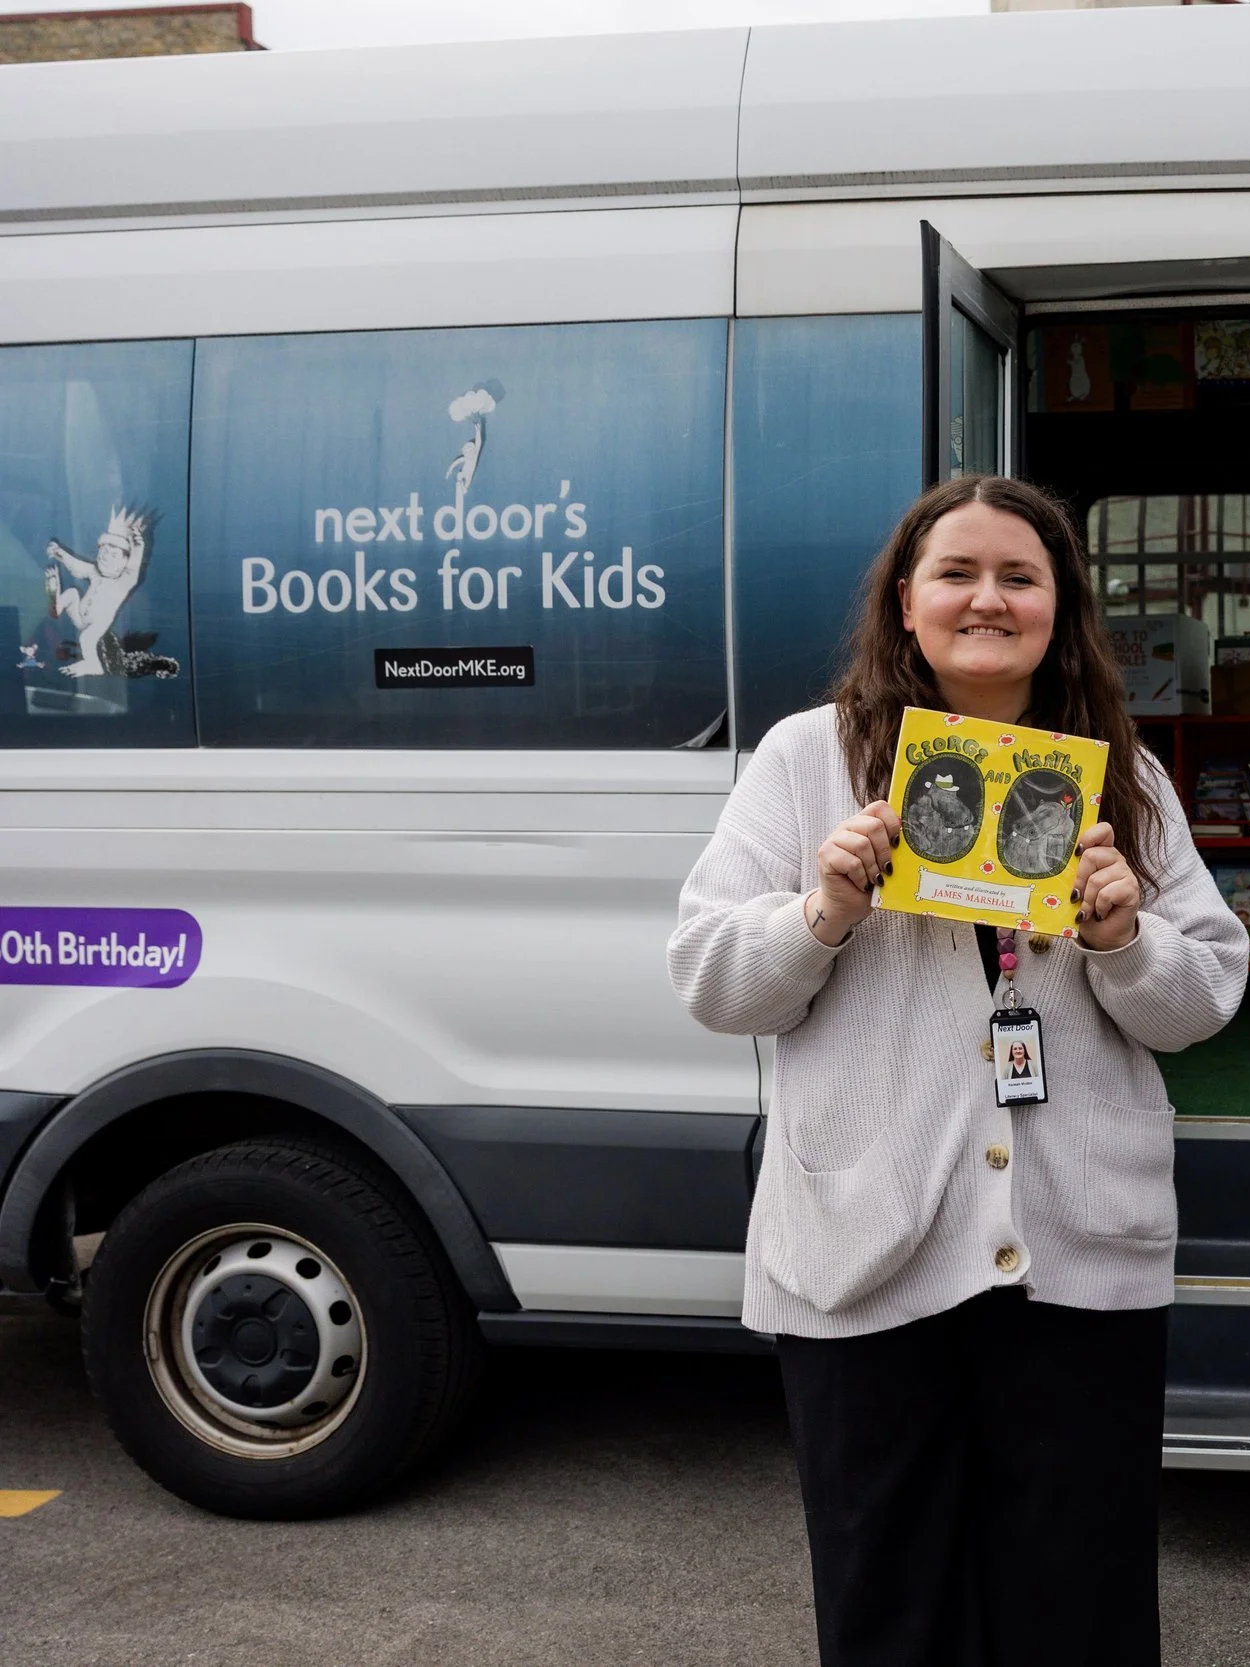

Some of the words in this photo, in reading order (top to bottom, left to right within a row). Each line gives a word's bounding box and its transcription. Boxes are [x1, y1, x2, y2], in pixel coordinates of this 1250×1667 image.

[315, 492, 423, 543] next
[433, 480, 587, 540] door's
[242, 551, 418, 614] Books
[438, 548, 522, 610] for
[542, 546, 666, 610] Kids
[1133, 630, 1148, 642] TO
[384, 659, 526, 680] NextDoorMKE.org
[906, 735, 988, 766] GEORGE
[984, 769, 1011, 785] AND
[932, 888, 962, 900] JAMES
[965, 894, 1015, 909] MARSHALL
[945, 883, 963, 891] written
[974, 886, 999, 896] illustrated
[0, 929, 52, 965] 0th
[58, 930, 187, 975] Birthday!
